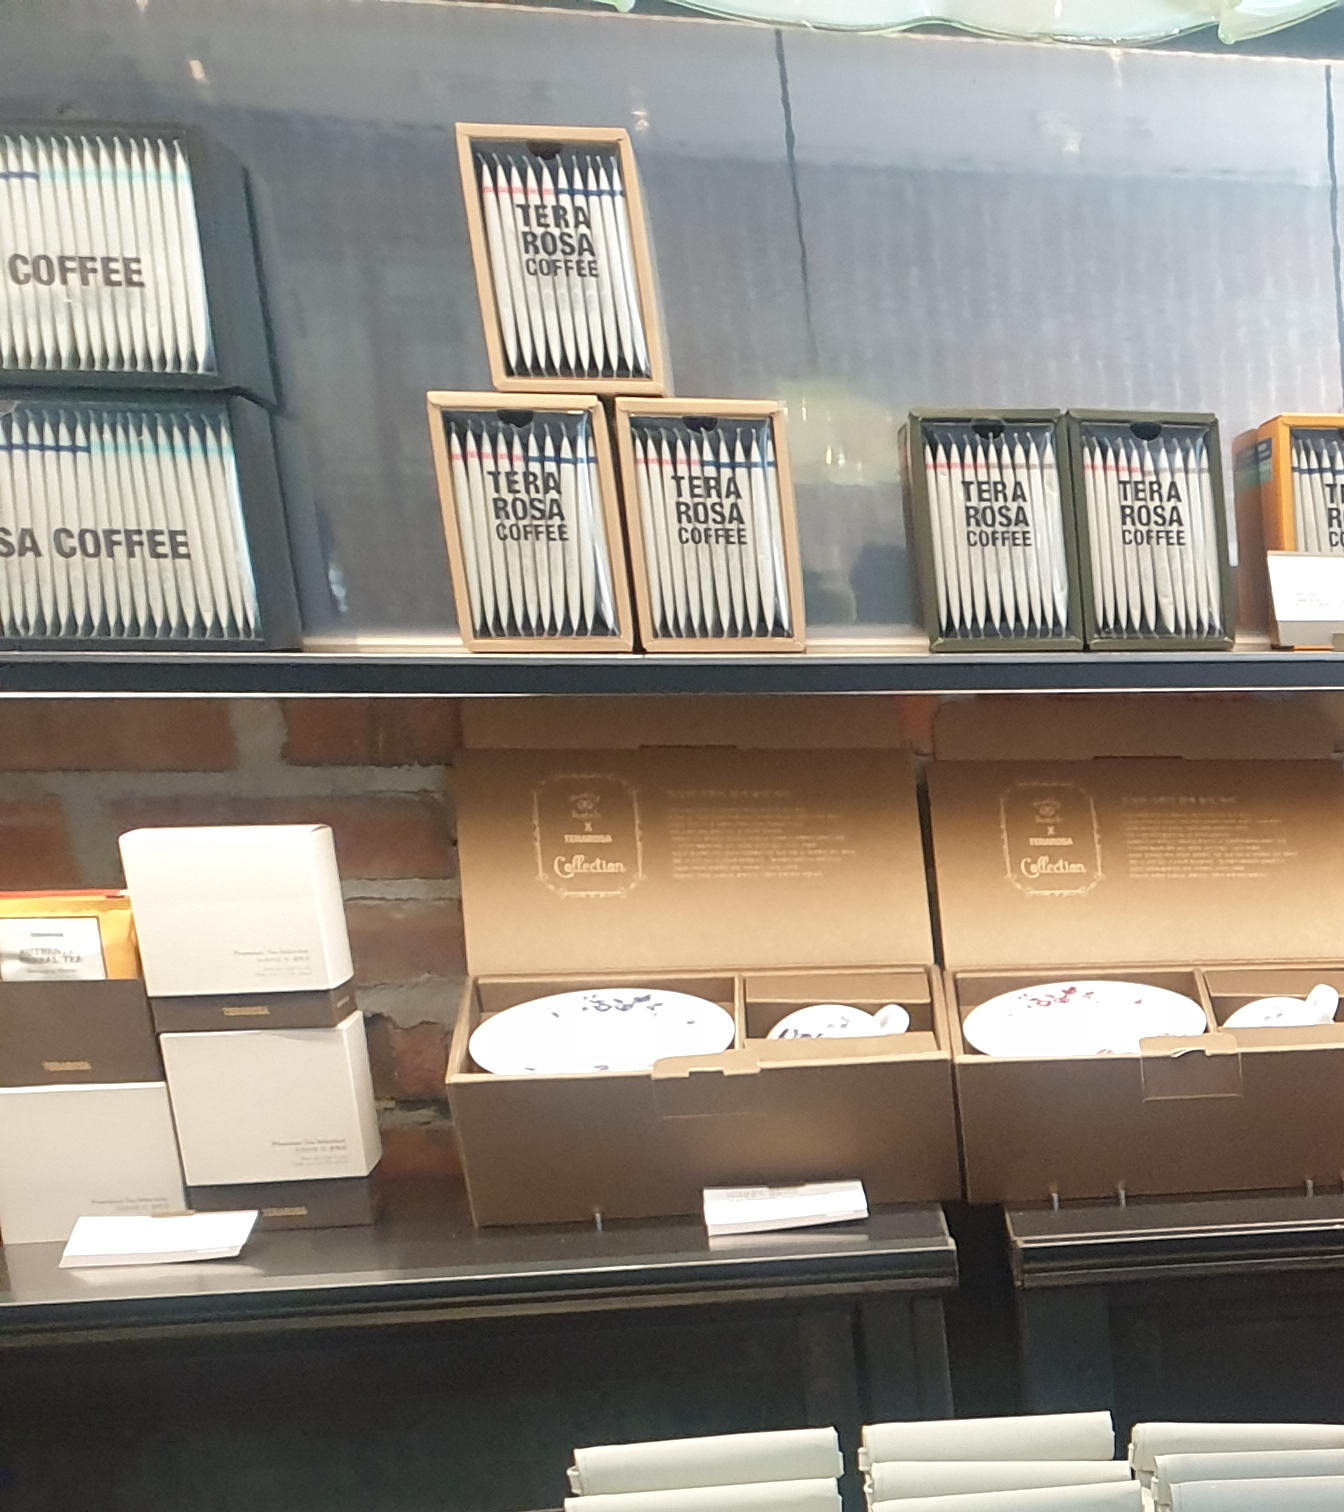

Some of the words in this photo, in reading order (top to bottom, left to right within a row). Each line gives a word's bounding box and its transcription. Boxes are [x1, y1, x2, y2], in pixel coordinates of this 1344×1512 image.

[517, 204, 591, 231] TERA
[523, 231, 596, 257] ROSA
[9, 253, 145, 288] COFFEE
[525, 255, 599, 279] COFFEE
[488, 472, 562, 497] TERA
[671, 476, 742, 501] TERA
[961, 481, 1026, 503] TERA
[1118, 481, 1179, 503] TERA
[493, 498, 565, 522] ROSA
[676, 502, 745, 525] ROSA
[964, 505, 1030, 529] ROSA
[1120, 505, 1184, 527] ROSA
[0, 530, 41, 559] SA
[54, 528, 191, 560] COFFEE
[496, 522, 569, 543] COFFEE
[677, 526, 748, 546] COFFEE
[966, 531, 1032, 547] COFFEE
[1122, 530, 1186, 546] COFFEE
[554, 855, 625, 878] Collection
[1021, 857, 1087, 878] Collection
